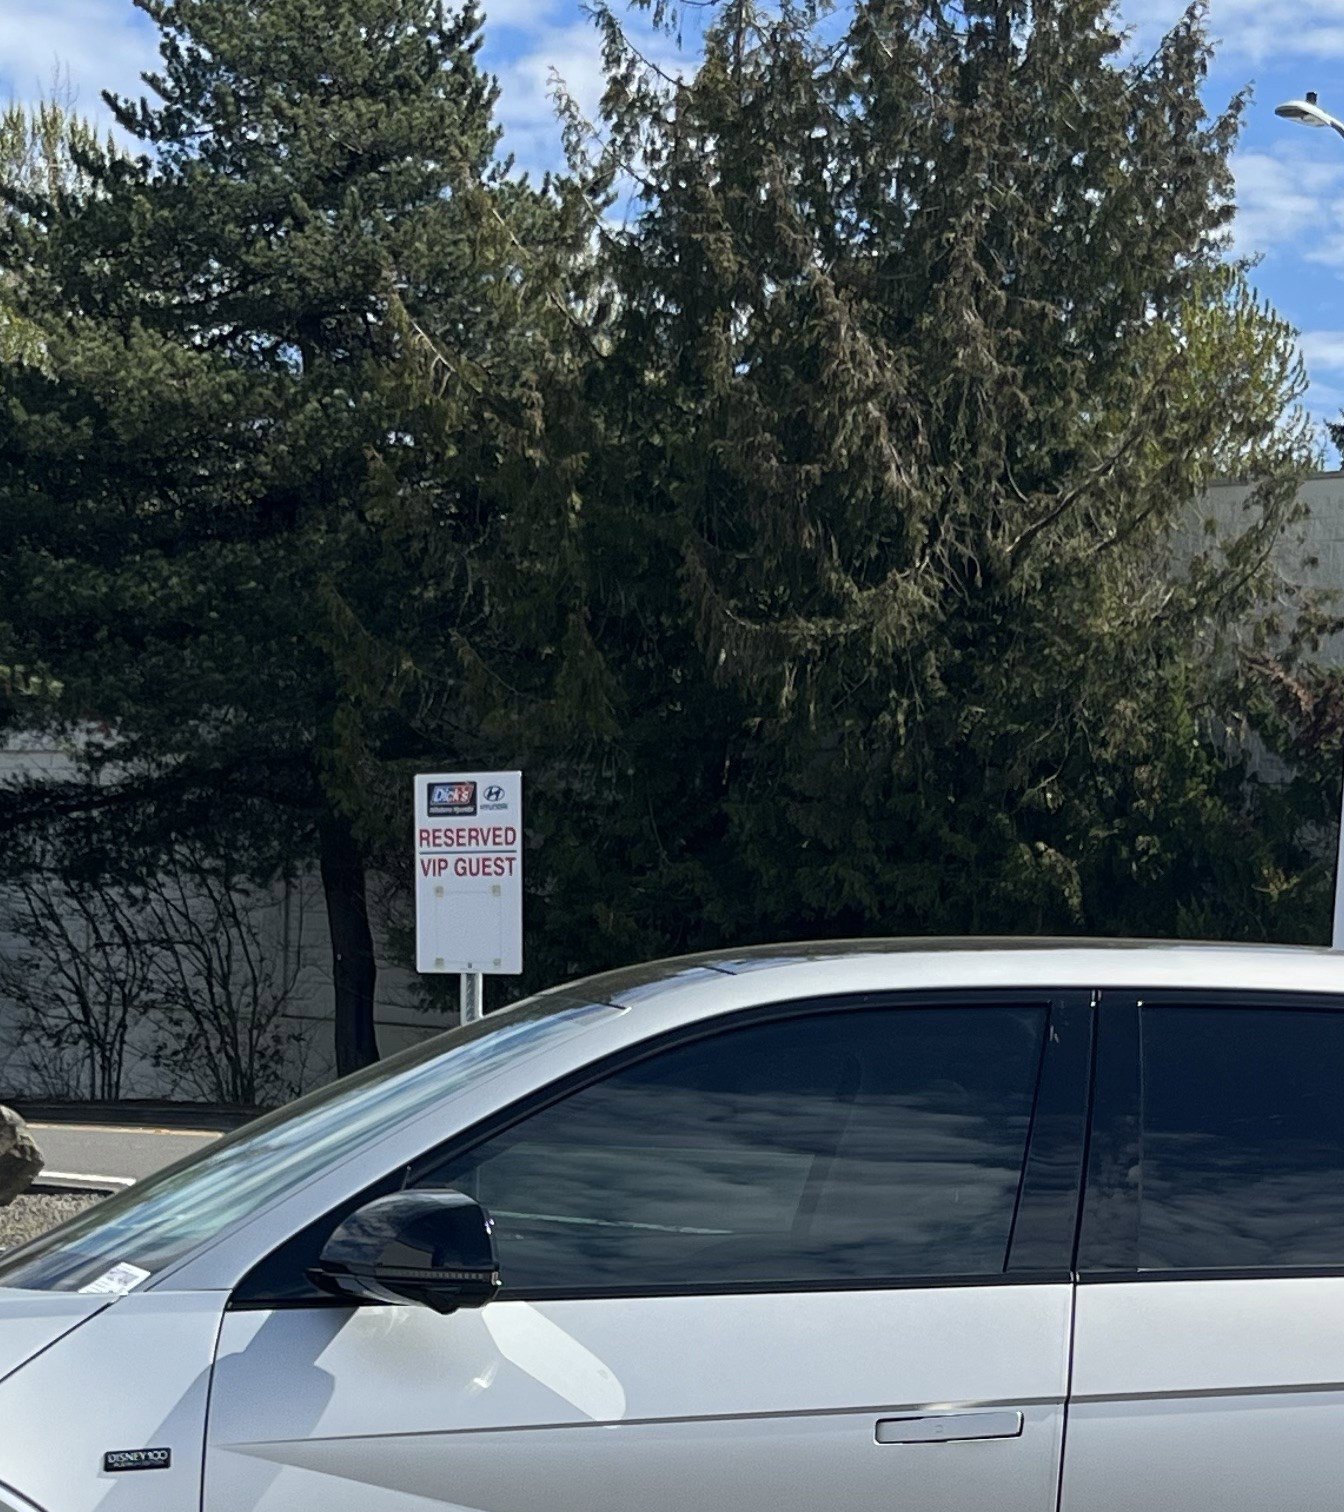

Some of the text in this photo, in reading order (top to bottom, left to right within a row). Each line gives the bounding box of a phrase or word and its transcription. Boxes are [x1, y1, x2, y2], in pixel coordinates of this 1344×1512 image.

[419, 826, 517, 848] RESERVED
[420, 856, 517, 877] VIP GUEST
